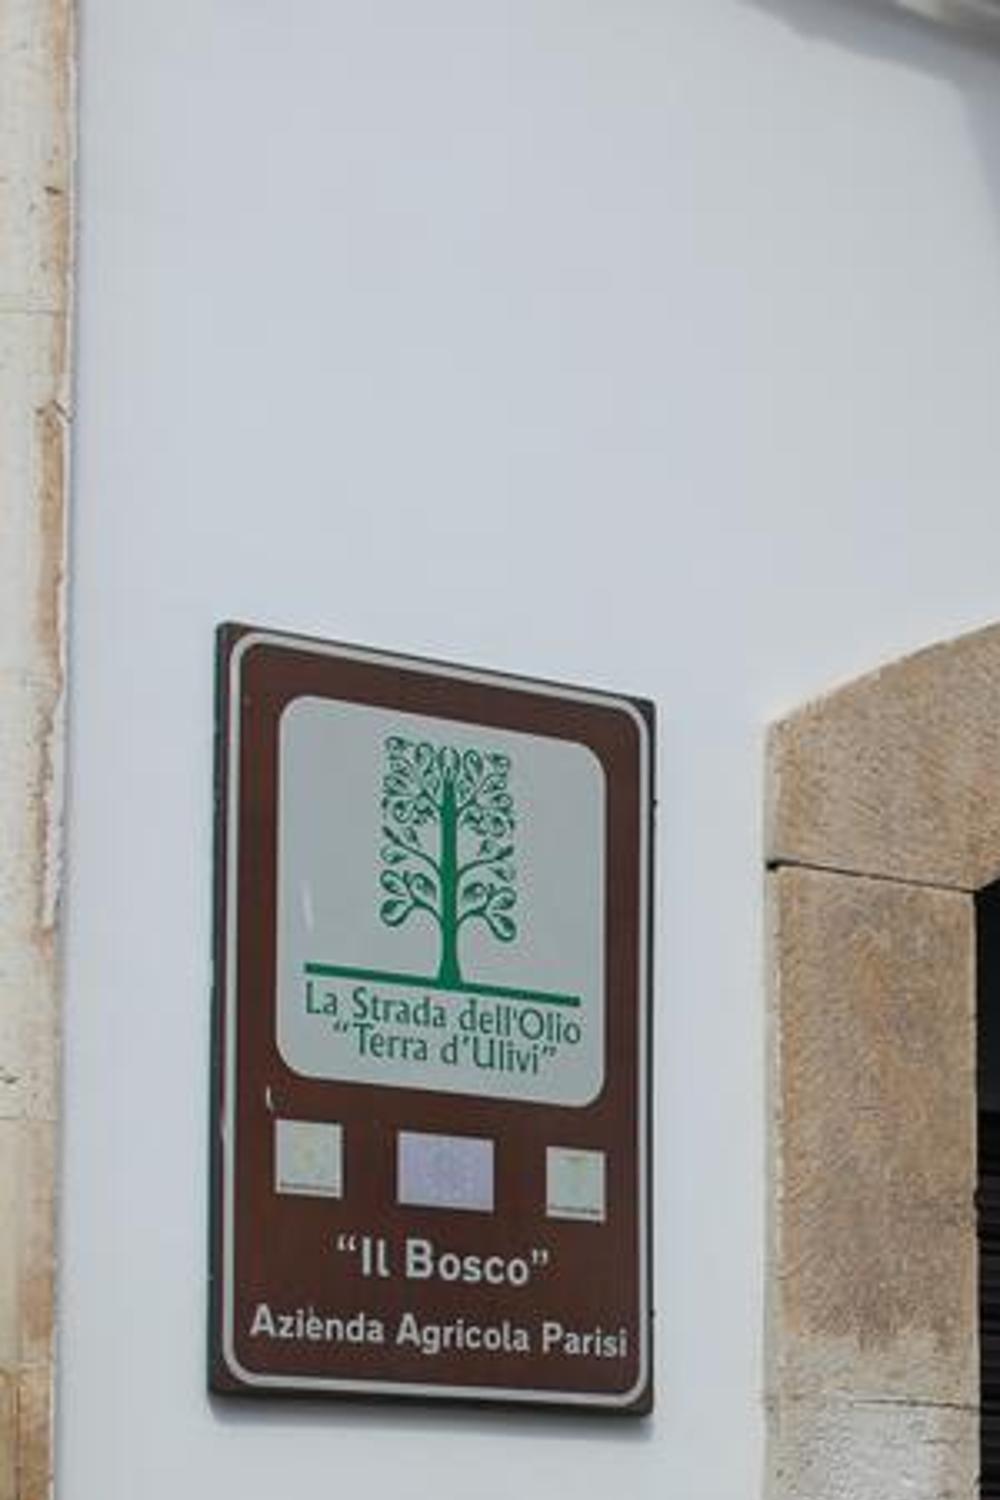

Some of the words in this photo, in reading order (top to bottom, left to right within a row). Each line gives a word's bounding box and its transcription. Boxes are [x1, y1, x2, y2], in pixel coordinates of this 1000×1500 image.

[305, 980, 338, 1016] La
[351, 986, 447, 1028] Strada
[458, 998, 582, 1045] dell'Olio
[332, 1020, 429, 1062] “Terra
[405, 1238, 550, 1287] Bosco”
[395, 1311, 531, 1355] Agricola
[541, 1320, 628, 1358] Parisi
